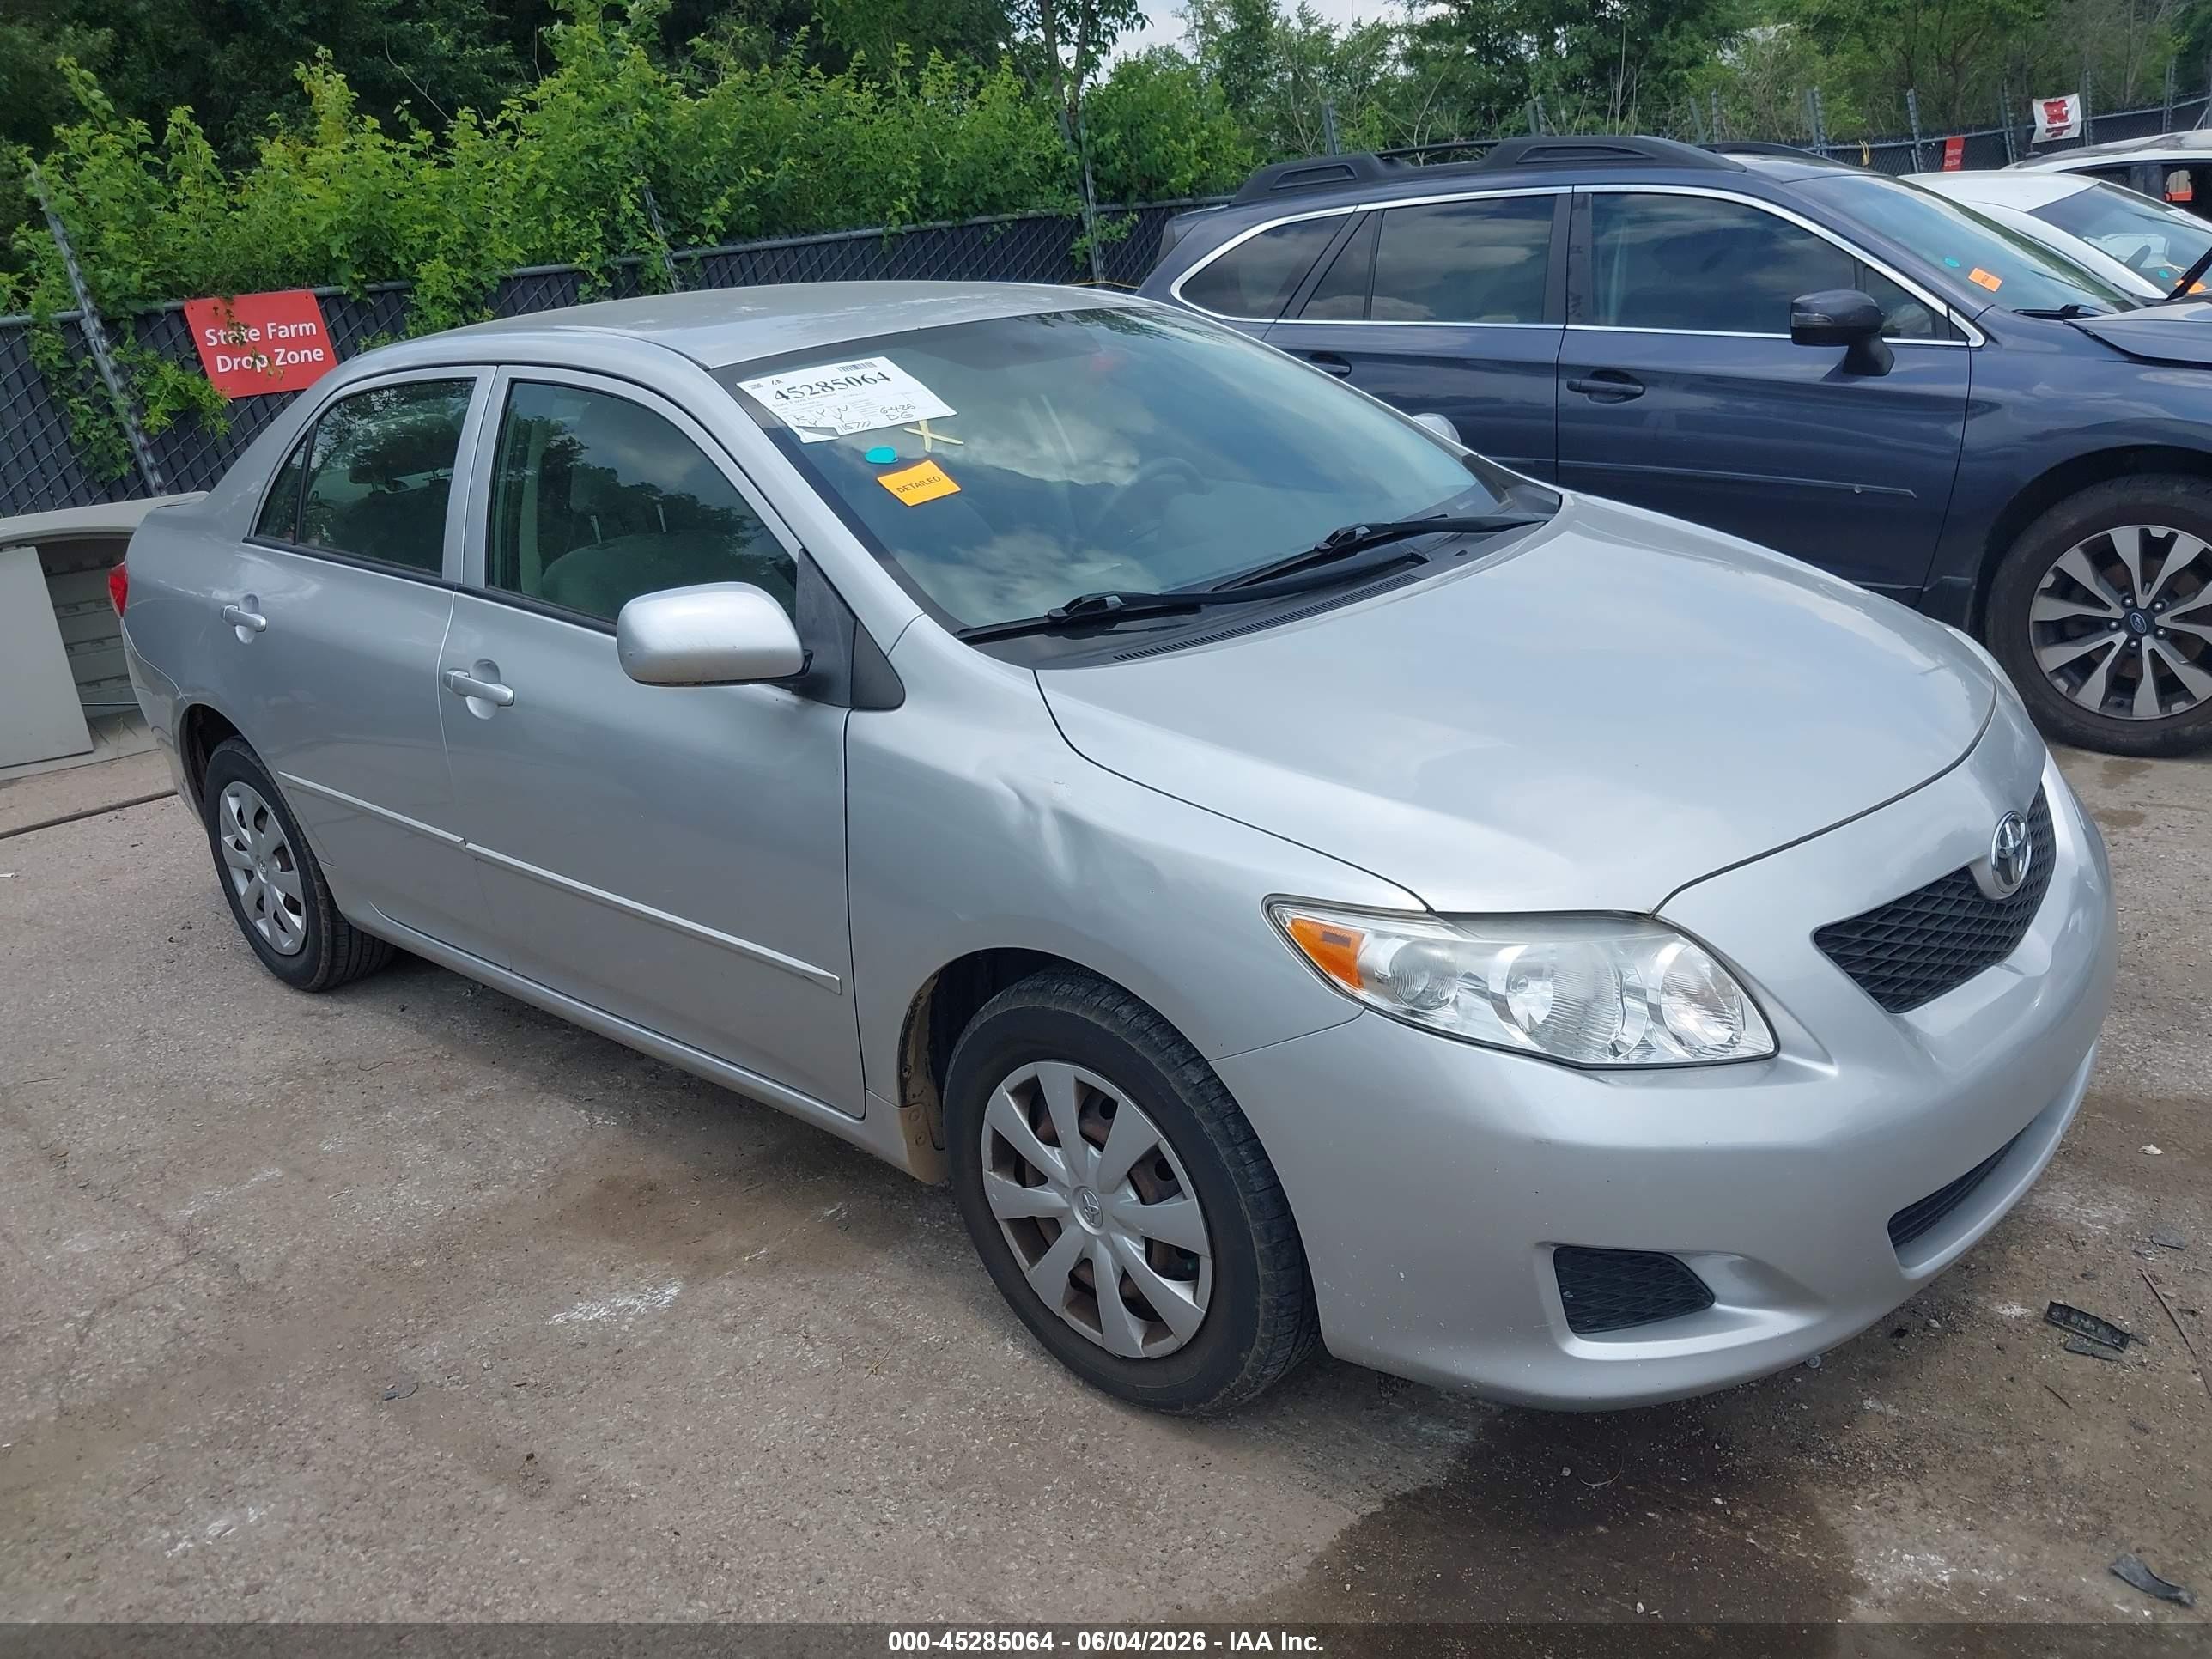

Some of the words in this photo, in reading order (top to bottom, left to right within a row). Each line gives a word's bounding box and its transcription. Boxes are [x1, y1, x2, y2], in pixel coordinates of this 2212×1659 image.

[205, 326, 261, 347] State
[267, 321, 317, 341] Farm
[216, 353, 269, 373] Drop
[274, 347, 324, 367] Zone
[775, 371, 892, 401] 45285064
[896, 476, 941, 494] DETAILED
